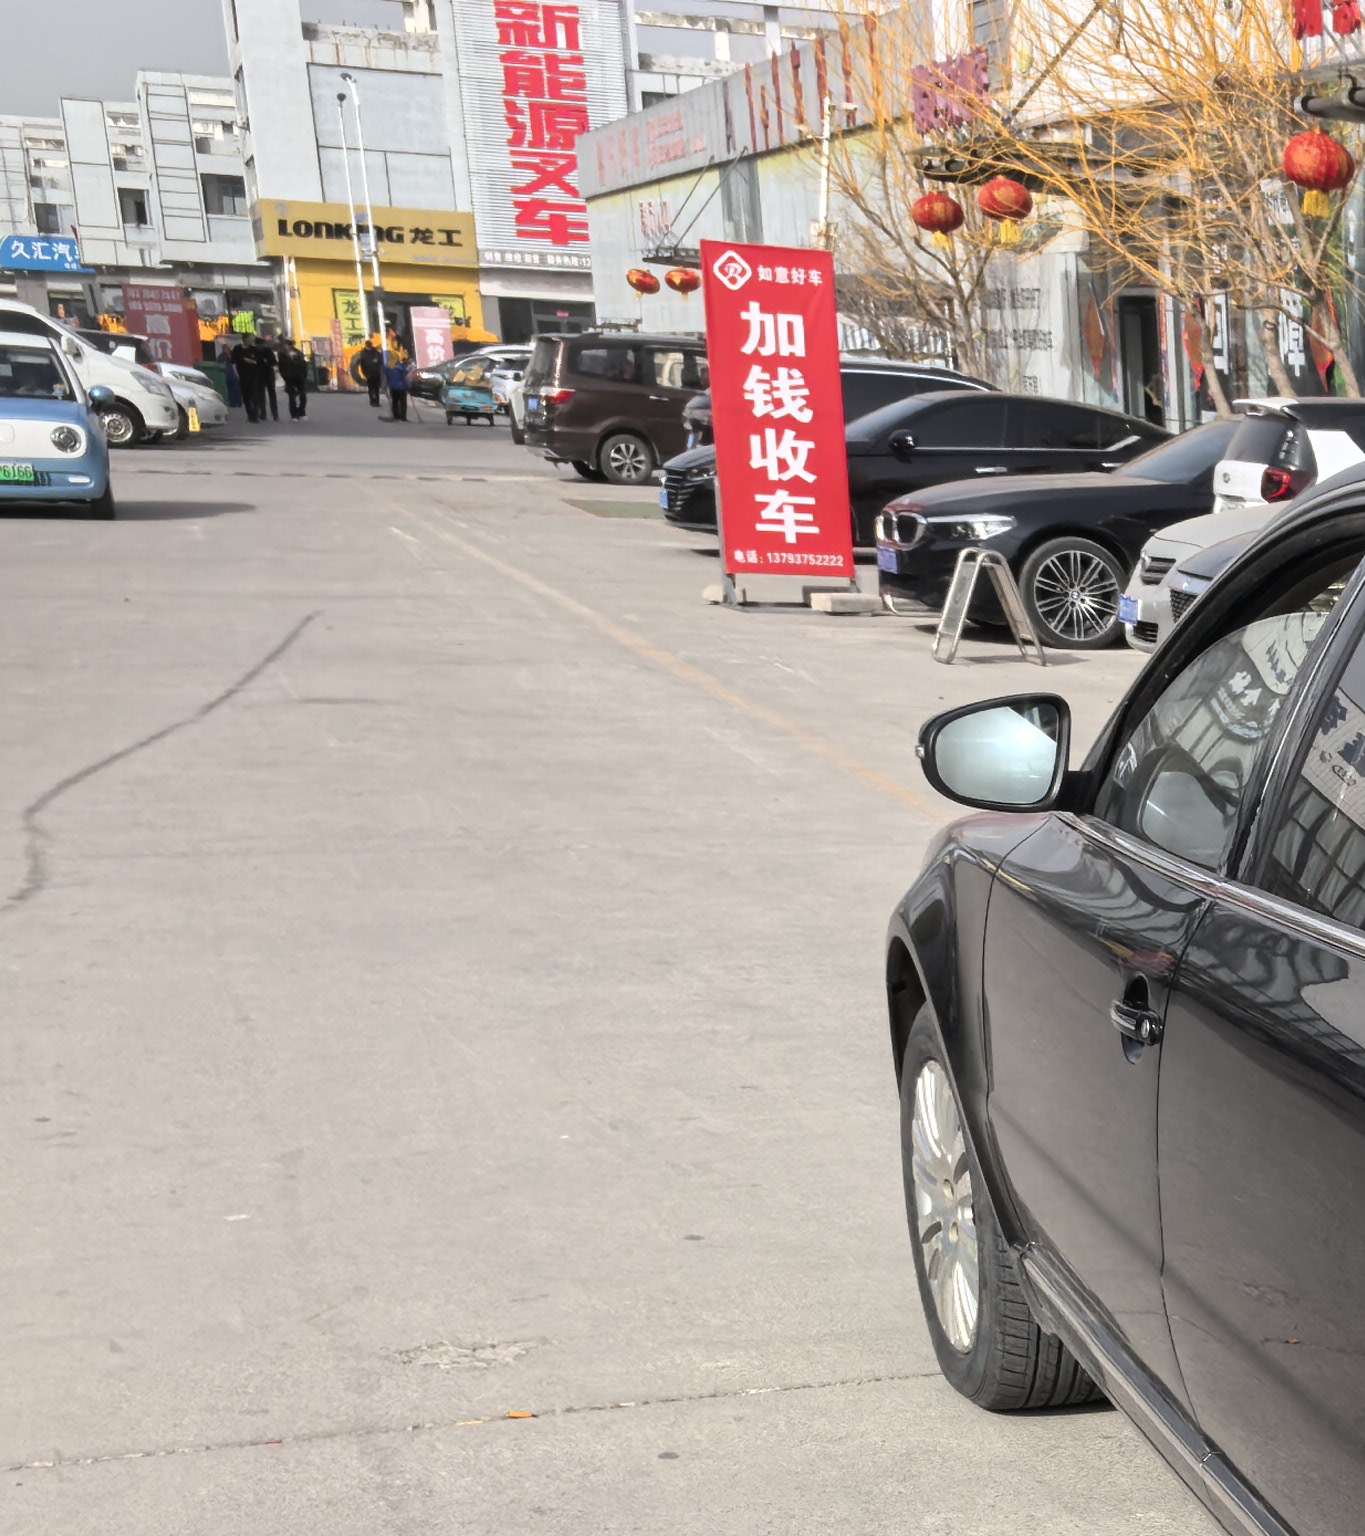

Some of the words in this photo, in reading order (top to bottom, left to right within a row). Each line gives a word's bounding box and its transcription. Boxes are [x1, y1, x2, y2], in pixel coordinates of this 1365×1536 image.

[493, 0, 590, 245] 新能源叉车
[409, 227, 463, 247] 龙工
[11, 240, 80, 260] 久汇汽
[757, 264, 823, 287] 如意好车
[740, 301, 820, 544] 加钱收车
